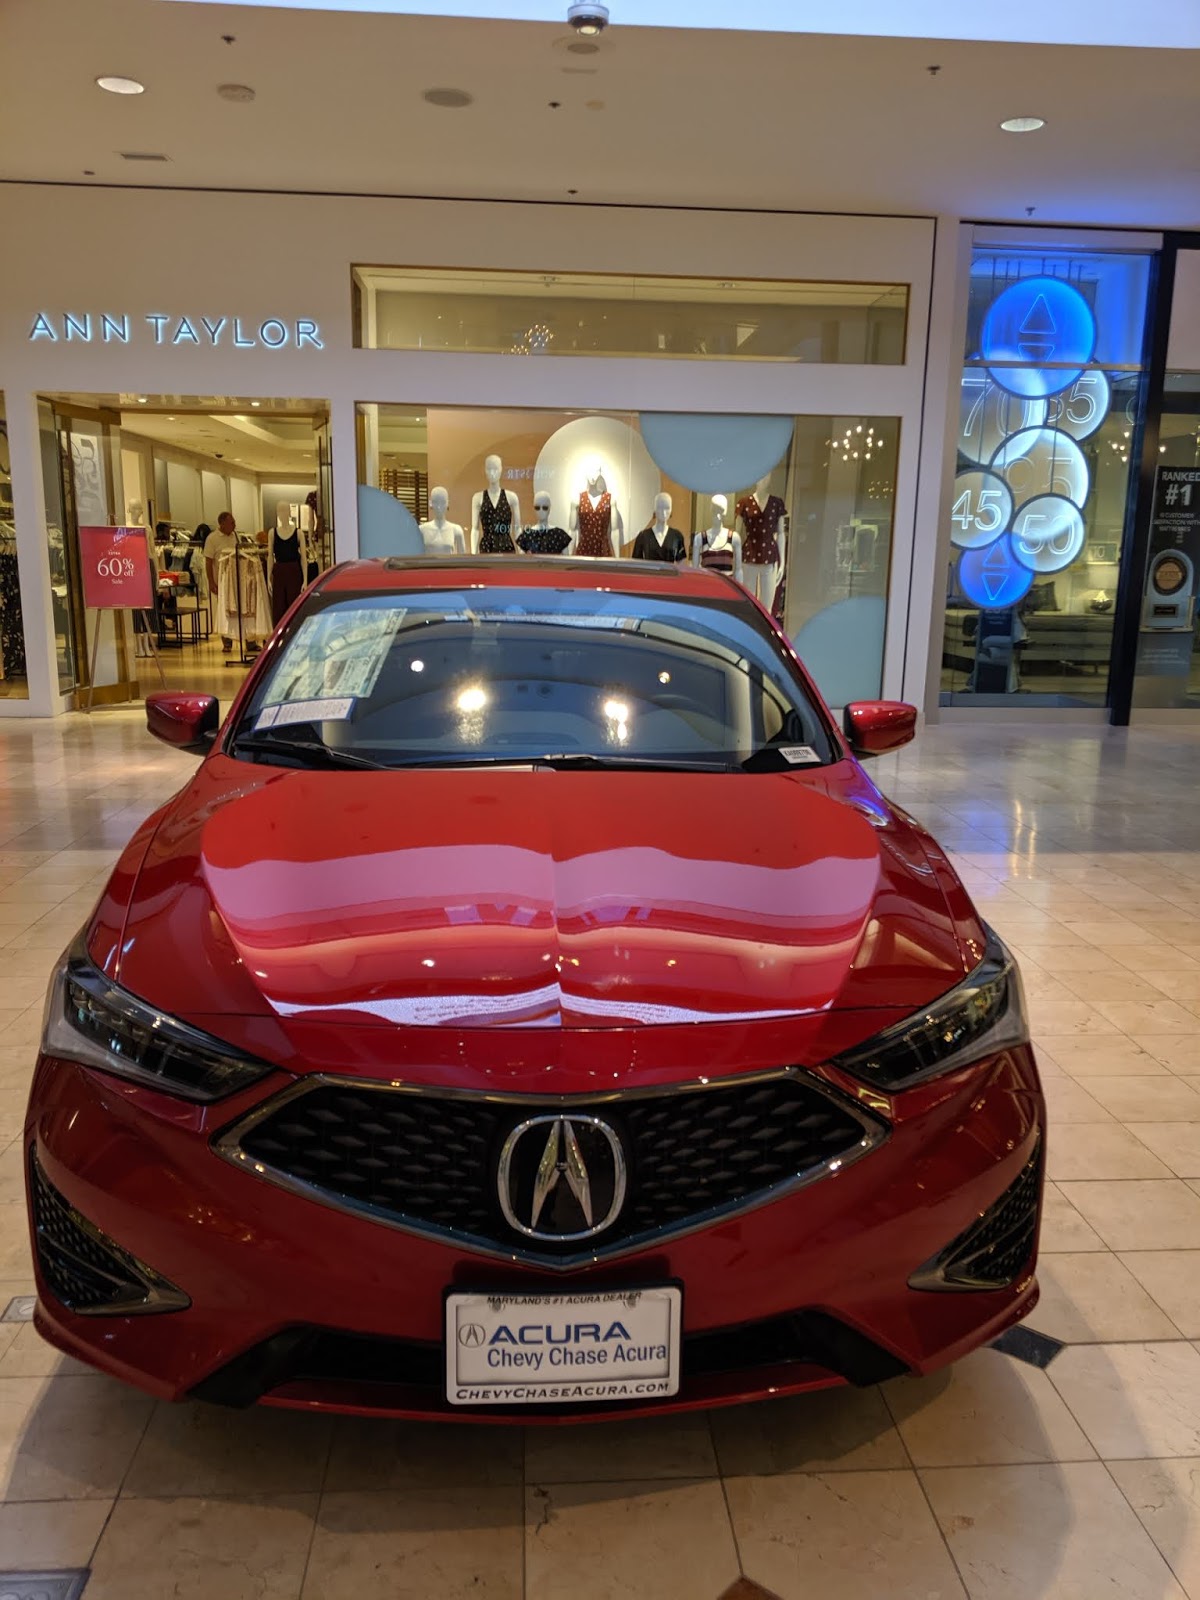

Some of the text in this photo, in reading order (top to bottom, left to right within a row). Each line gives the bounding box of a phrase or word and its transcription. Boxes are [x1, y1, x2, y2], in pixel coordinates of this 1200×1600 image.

[28, 312, 324, 349] ANN TAYLOR
[1165, 484, 1192, 506] #1
[951, 489, 1002, 531] 45
[1019, 514, 1075, 555] 50
[487, 1292, 642, 1305] MARYLAND'S #1 ACURA DEALER
[487, 1321, 632, 1346] ACURA
[487, 1343, 667, 1371] Chevy Chase Acura
